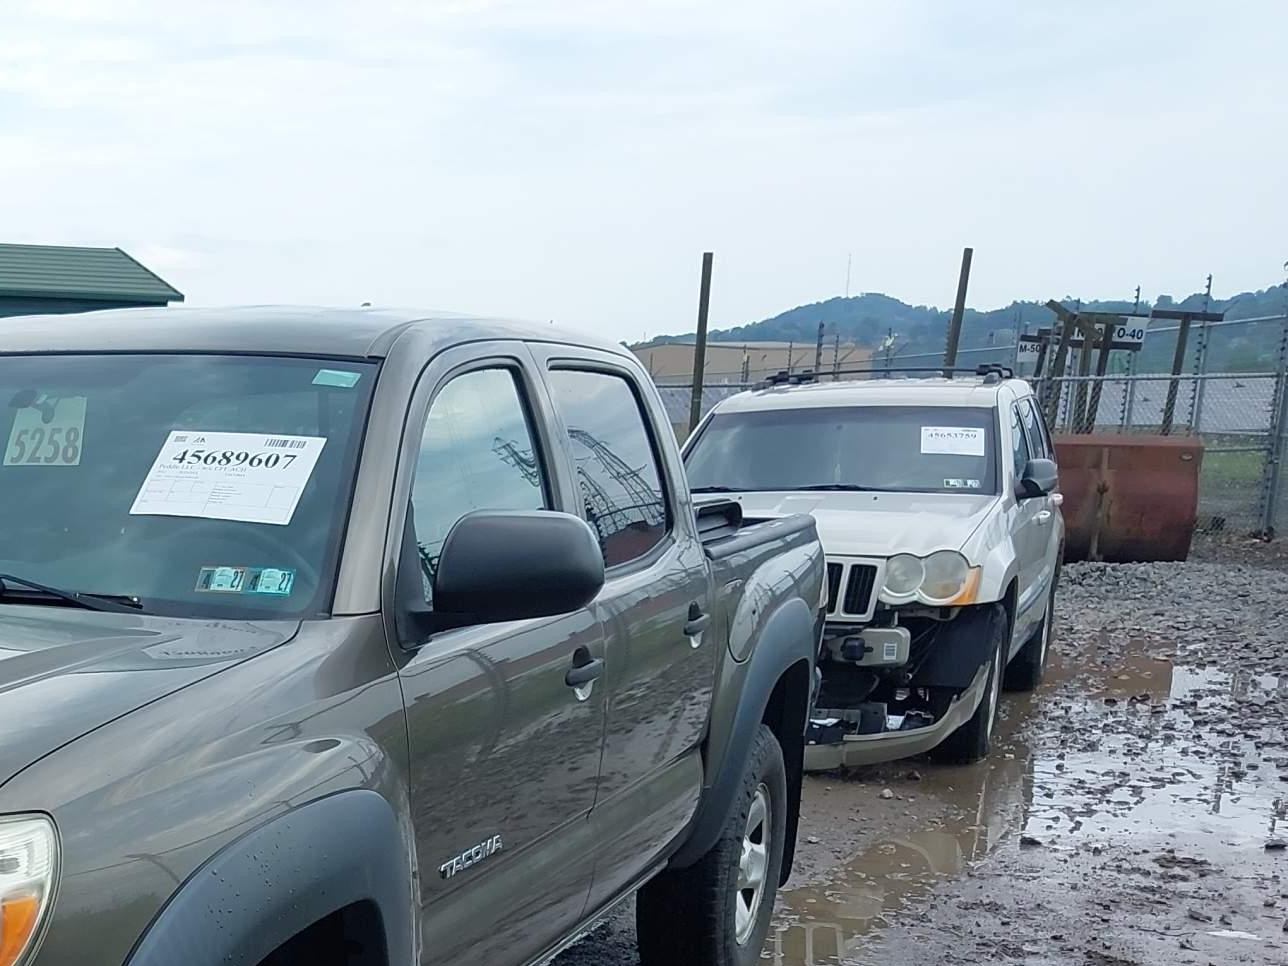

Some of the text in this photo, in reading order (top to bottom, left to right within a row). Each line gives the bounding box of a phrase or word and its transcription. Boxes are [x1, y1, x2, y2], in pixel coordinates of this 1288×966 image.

[1117, 327, 1144, 340] O-40
[1018, 343, 1041, 353] M-50
[9, 426, 80, 464] 5258
[172, 449, 297, 470] 45689607
[230, 570, 245, 591] 27
[278, 572, 292, 592] 27
[438, 834, 504, 879] TACOMA
